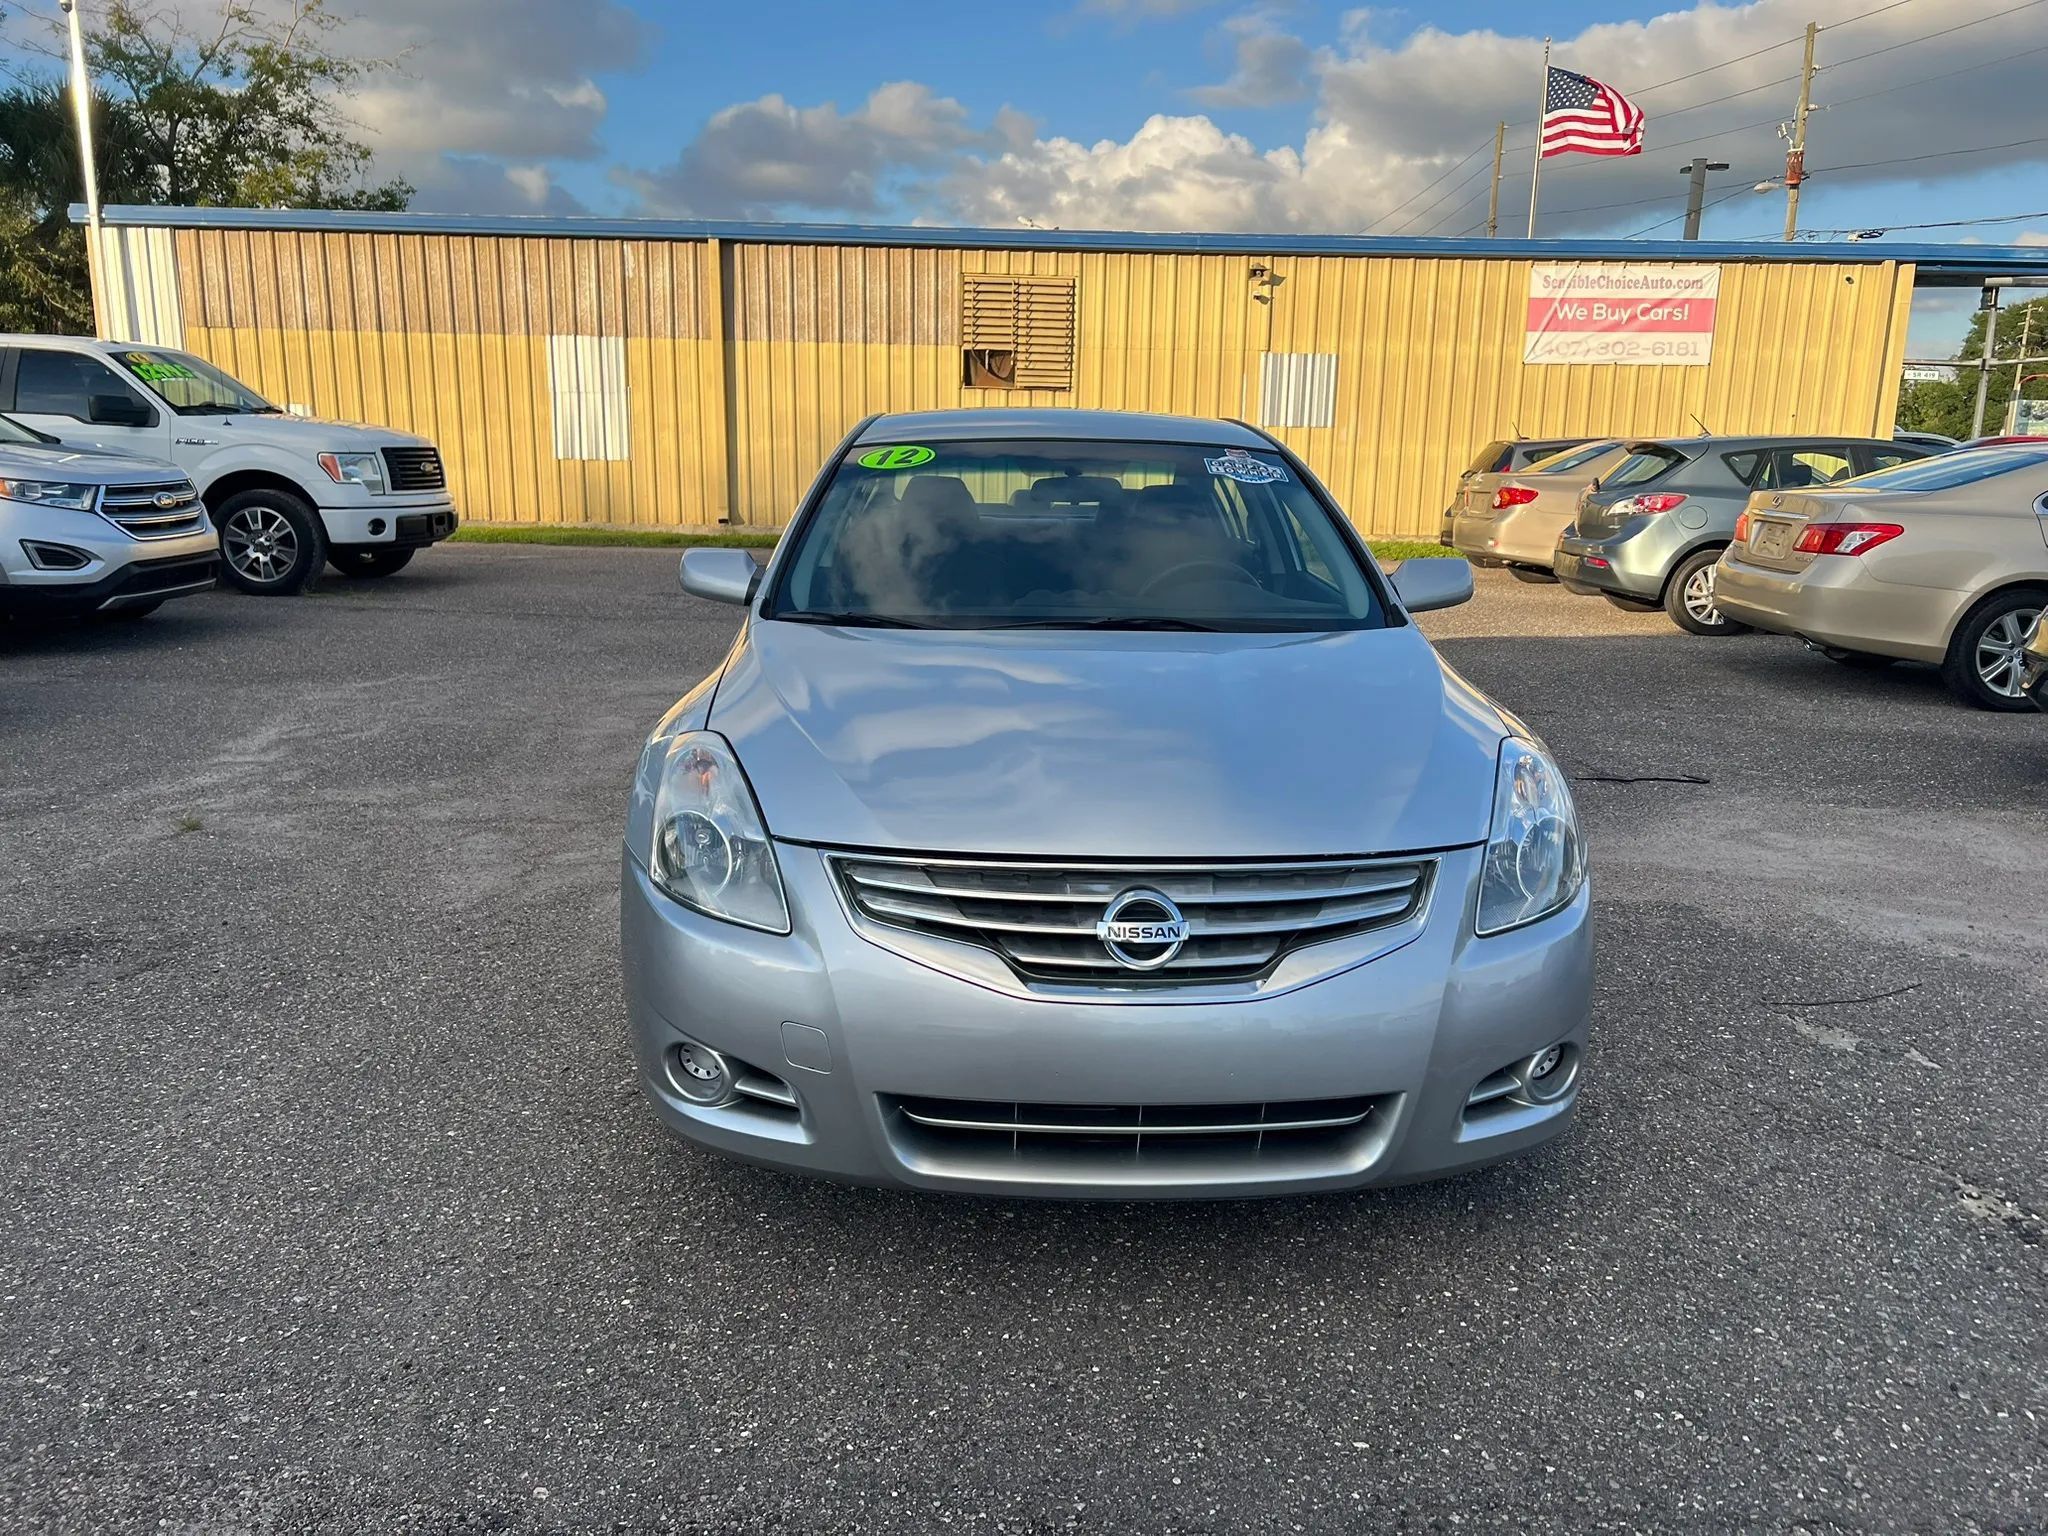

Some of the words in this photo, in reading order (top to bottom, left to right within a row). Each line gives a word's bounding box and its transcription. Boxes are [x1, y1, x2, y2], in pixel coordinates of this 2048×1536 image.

[1542, 274, 1704, 290] SenibleChoiceAuto.com
[1556, 303, 1588, 320] We
[1592, 303, 1632, 325] Buy
[1637, 303, 1689, 321] Cars!
[876, 448, 920, 465] 12
[1107, 926, 1181, 939] NISSAN
